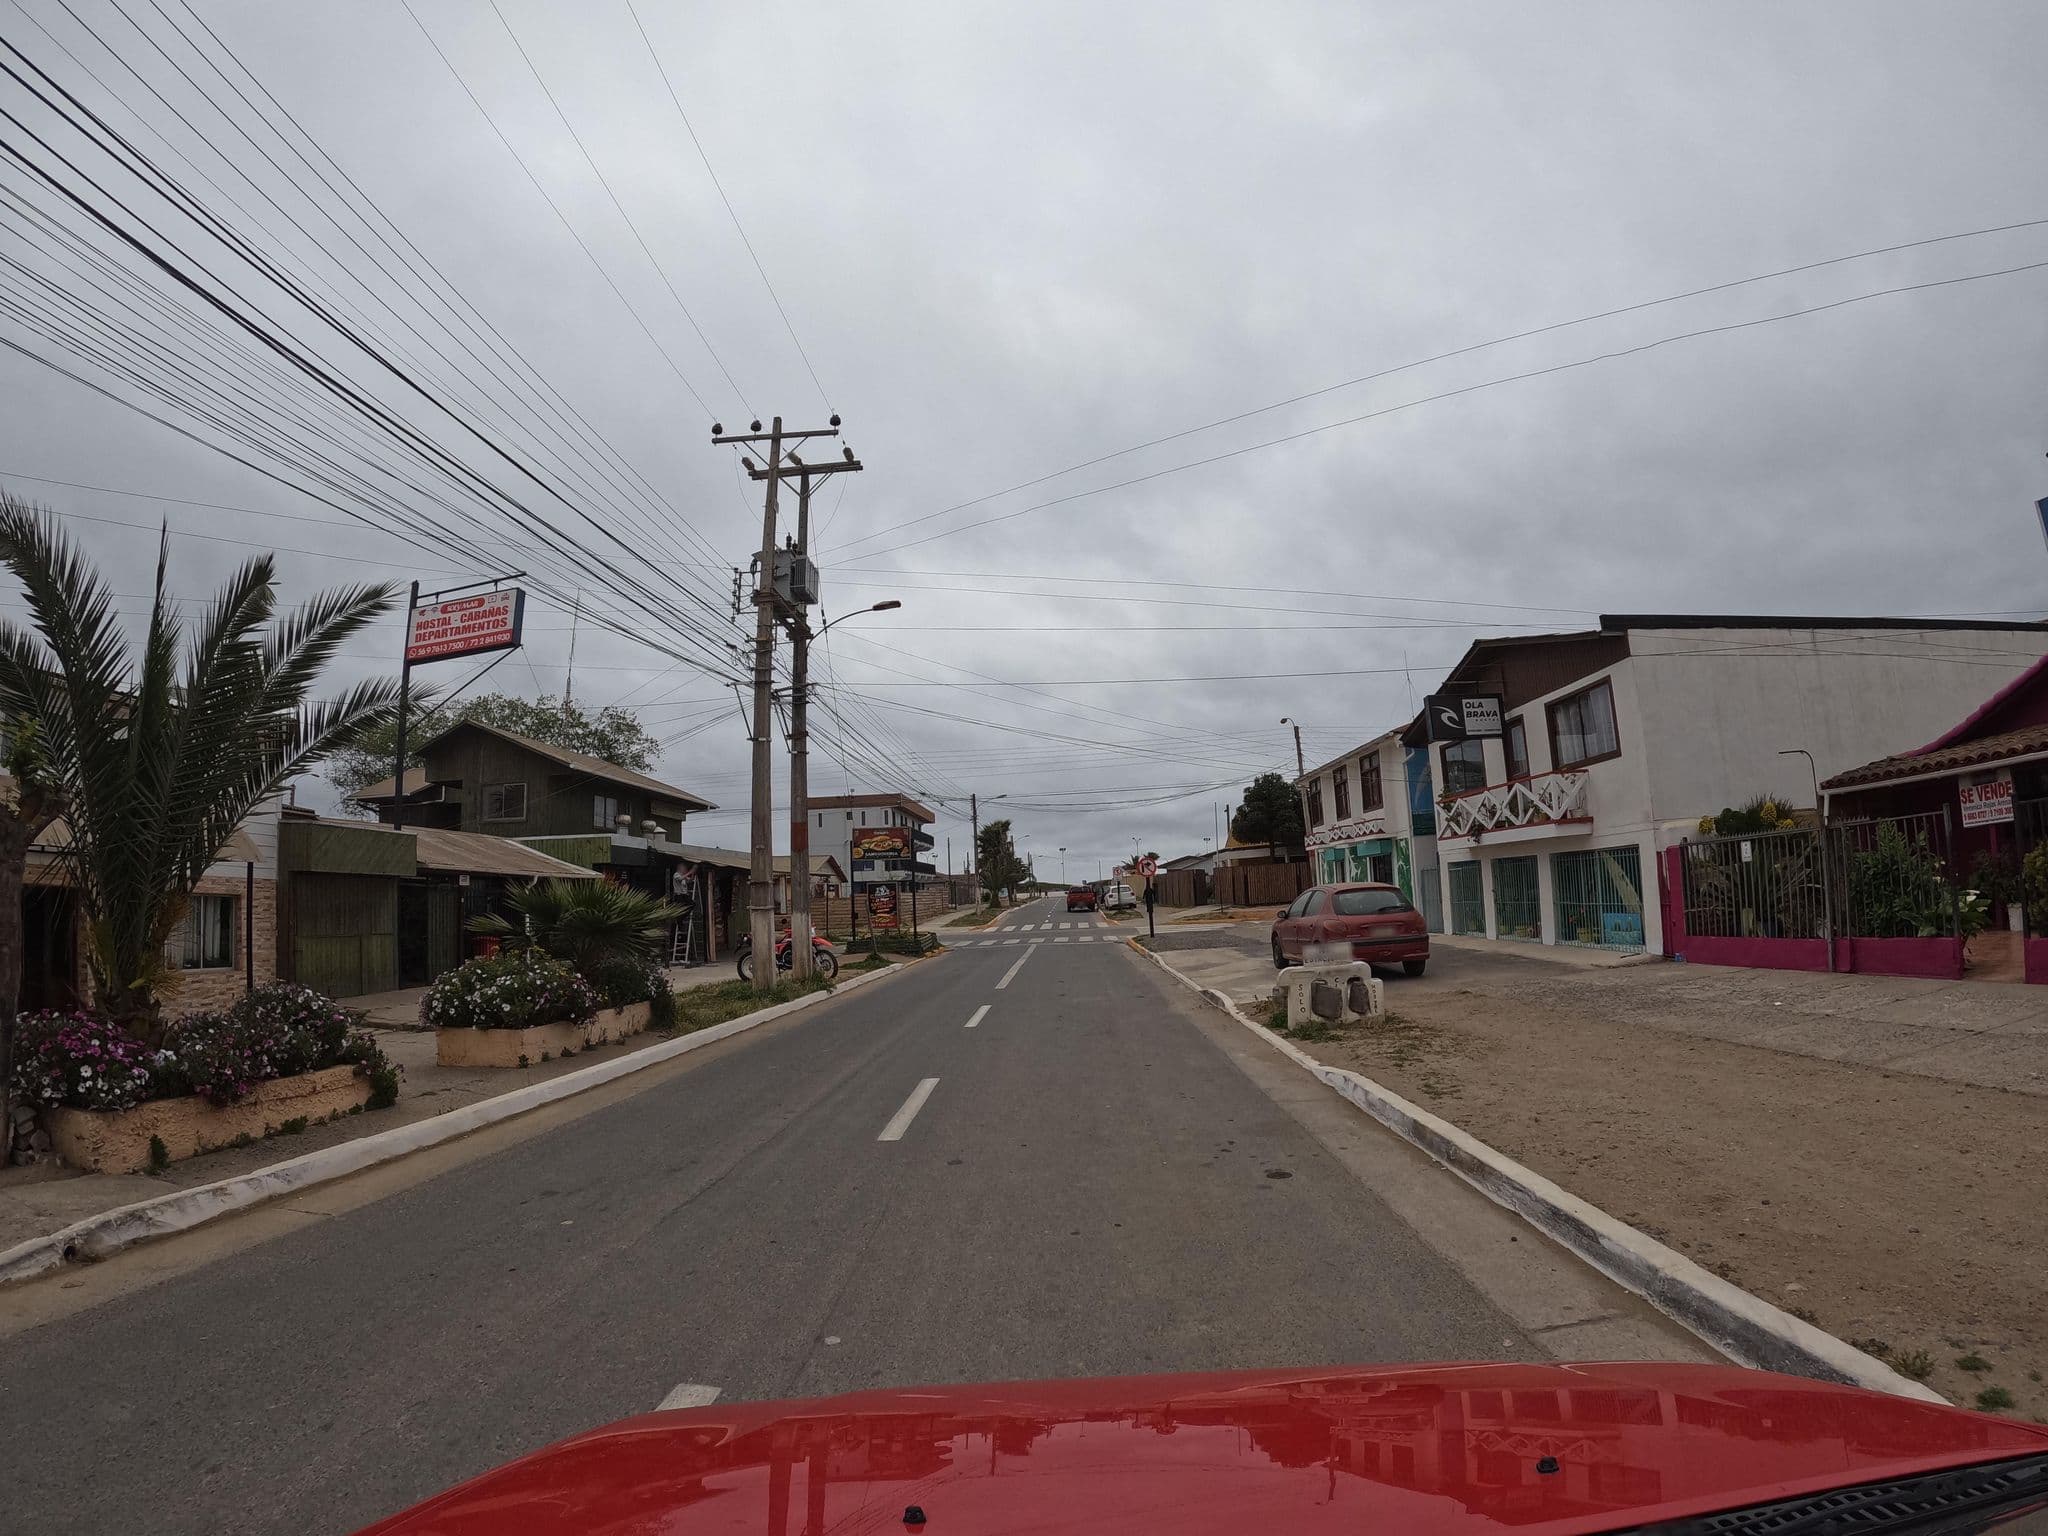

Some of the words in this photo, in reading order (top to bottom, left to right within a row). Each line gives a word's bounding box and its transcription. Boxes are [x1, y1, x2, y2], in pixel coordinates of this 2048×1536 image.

[415, 616, 452, 631] HOSTAL
[460, 605, 509, 624] CABAÑAS
[415, 617, 508, 643] DEPARTAMENTOS
[425, 646, 431, 655] 9
[1465, 701, 1484, 709] OLA
[1466, 710, 1498, 718] BRAVA
[1960, 787, 1974, 804] SE
[1976, 780, 2012, 801] VENDE
[1298, 983, 1306, 1013] SOLO
